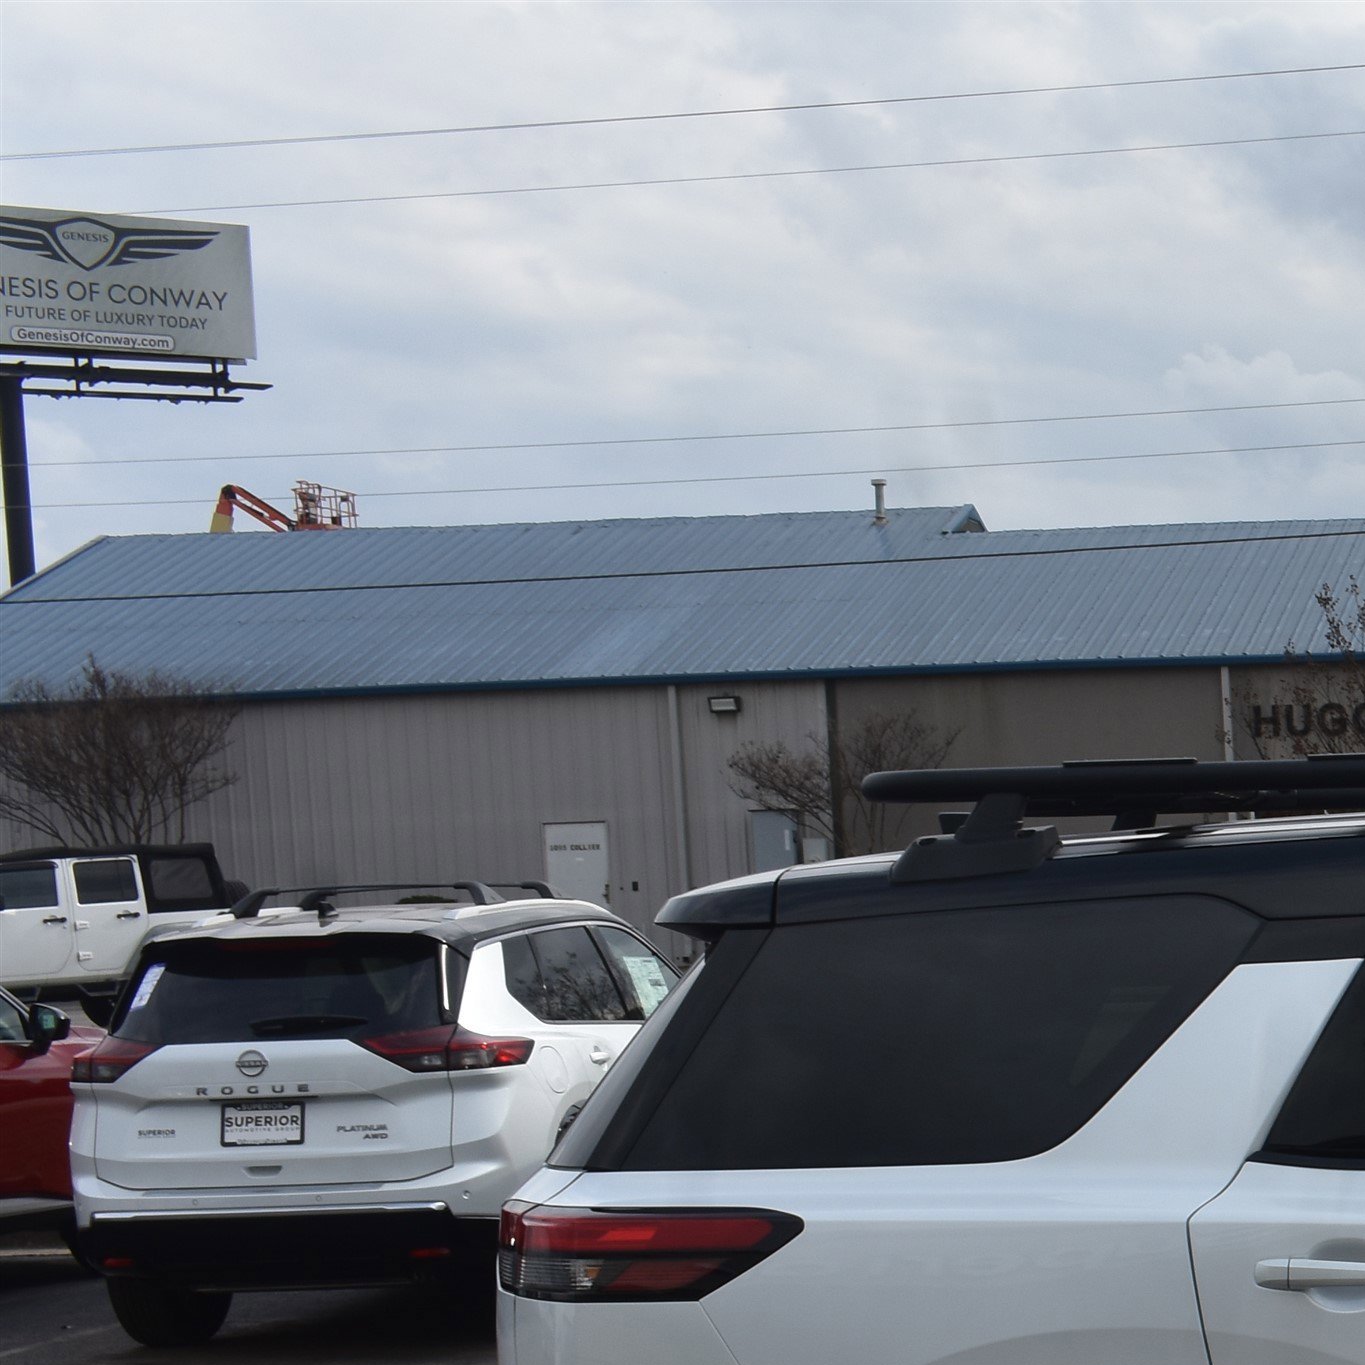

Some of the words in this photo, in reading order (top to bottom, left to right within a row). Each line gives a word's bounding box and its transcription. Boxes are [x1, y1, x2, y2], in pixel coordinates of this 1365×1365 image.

[62, 231, 109, 243] GENESIS
[67, 281, 100, 302] OF
[108, 284, 228, 311] CONWAY
[5, 305, 66, 321] FUTURE
[71, 309, 91, 322] OF
[96, 311, 154, 327] LUXURY
[158, 315, 208, 330] TODAY
[17, 328, 169, 349] GenesisOfConway.com
[196, 1083, 310, 1096] ROGUE
[225, 1115, 300, 1127] SUPERIOR
[138, 1129, 176, 1137] SUPERIOR
[336, 1125, 388, 1133] PLATINUM
